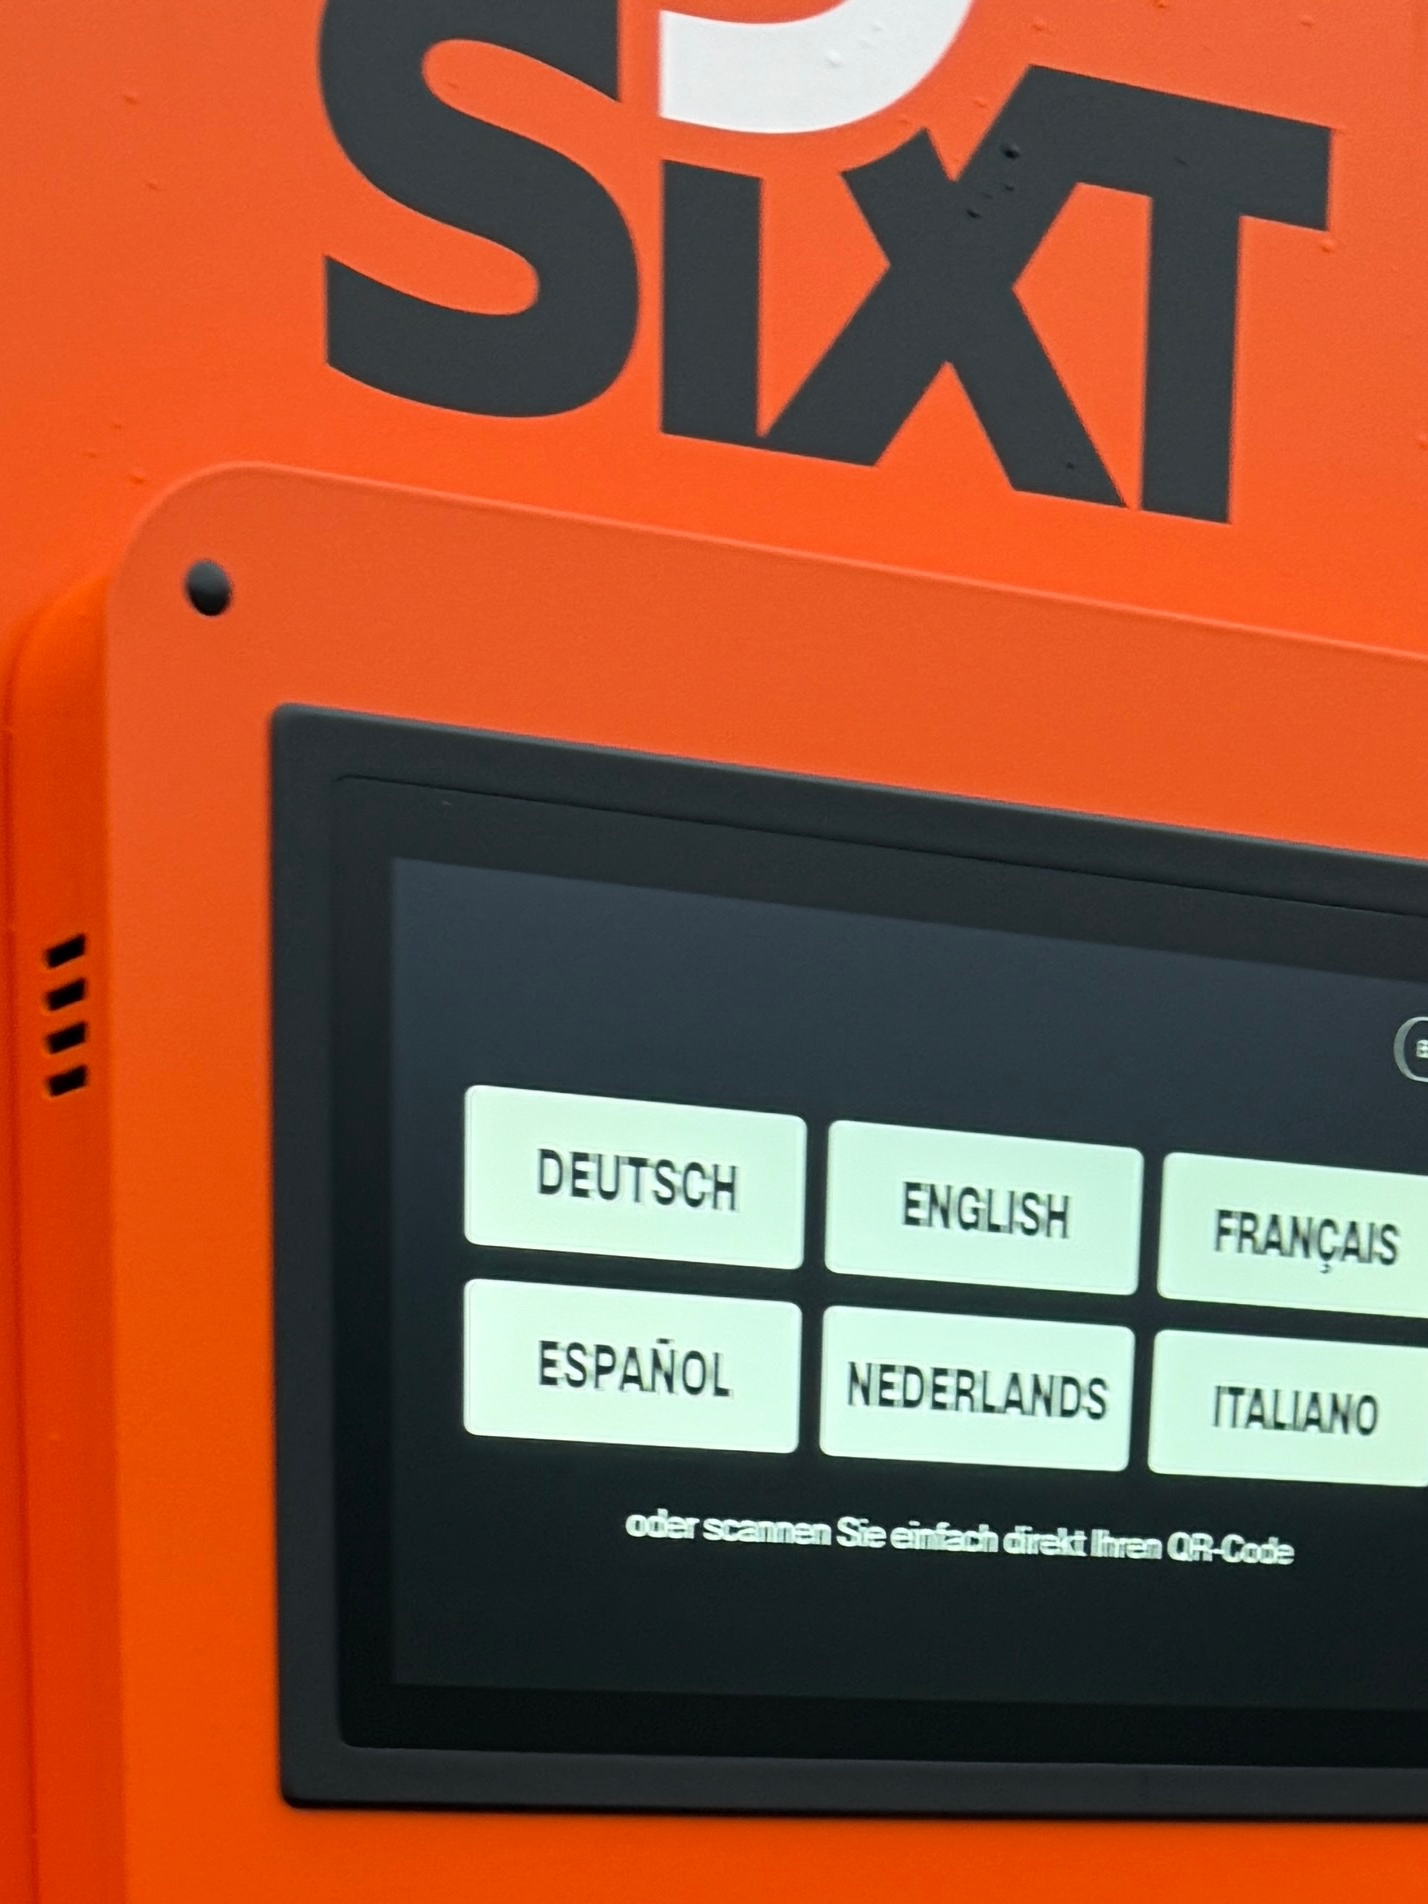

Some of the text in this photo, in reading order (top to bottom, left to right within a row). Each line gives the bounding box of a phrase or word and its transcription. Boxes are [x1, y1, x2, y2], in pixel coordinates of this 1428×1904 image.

[538, 1148, 740, 1213] DEUTSCH
[902, 1181, 1070, 1240] ENGLISH
[1214, 1208, 1400, 1274] FRANÇAIS
[538, 1337, 730, 1399] ESPAÑOL
[848, 1361, 1109, 1421] NEDERLANDS
[1213, 1385, 1378, 1437] ITALIANO
[625, 1508, 1296, 1566] oder scannen Sie einfach direkt Ihren QR-Code
